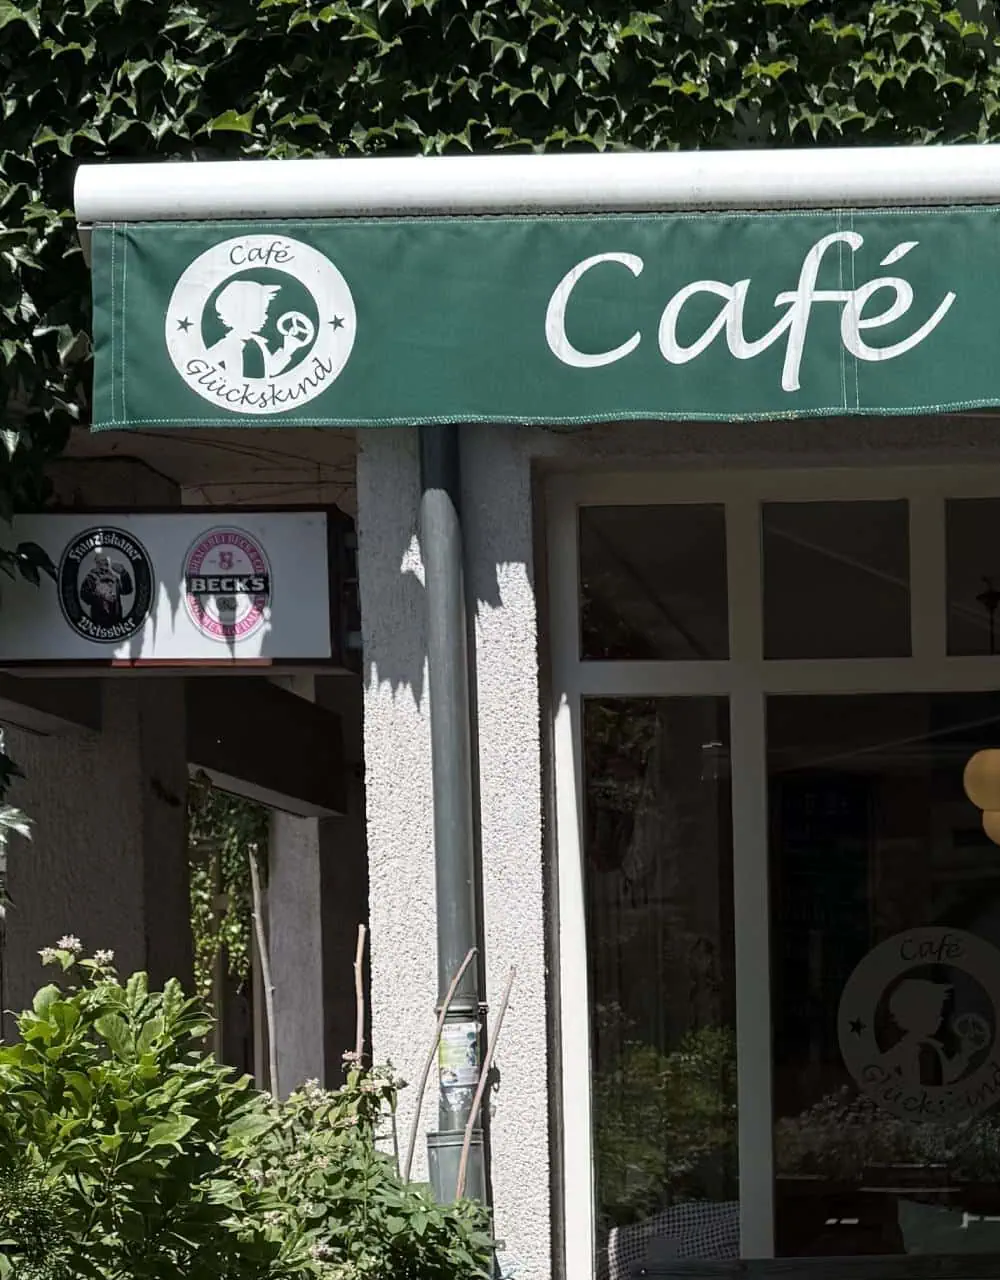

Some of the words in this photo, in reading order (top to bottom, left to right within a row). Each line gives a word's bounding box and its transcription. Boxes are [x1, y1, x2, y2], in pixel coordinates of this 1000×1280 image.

[229, 241, 296, 266] Café
[545, 230, 957, 393] Café
[186, 356, 334, 408] Glückskind
[190, 575, 266, 593] BECK'S
[77, 616, 137, 638] Weissbier
